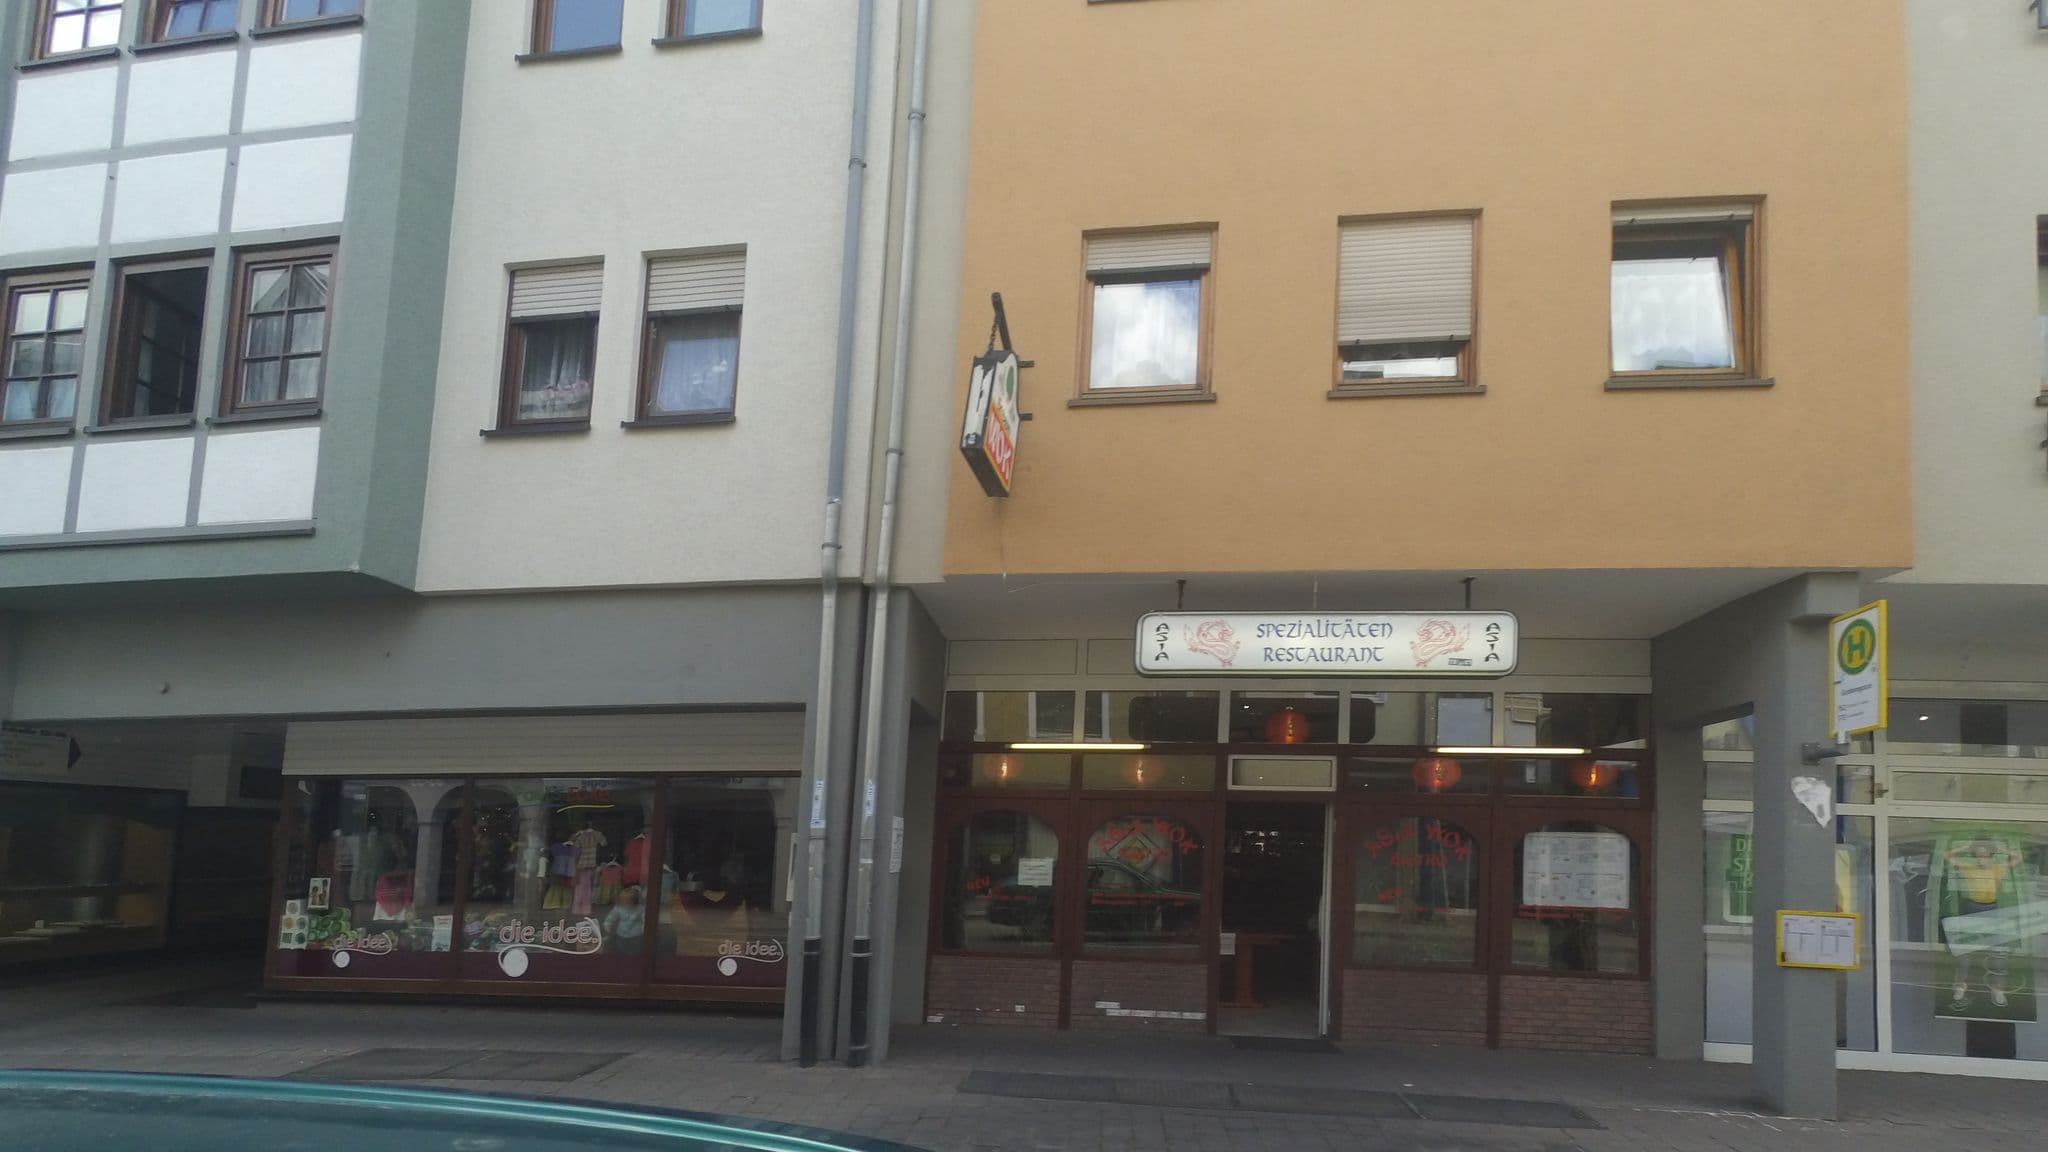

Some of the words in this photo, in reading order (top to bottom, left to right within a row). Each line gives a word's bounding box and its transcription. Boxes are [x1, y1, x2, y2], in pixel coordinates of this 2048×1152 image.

[1154, 622, 1170, 662] ASIA
[1484, 622, 1501, 662] ASIA
[1262, 645, 1385, 666] RESTAURANT
[499, 919, 535, 943] die
[718, 939, 743, 955] die
